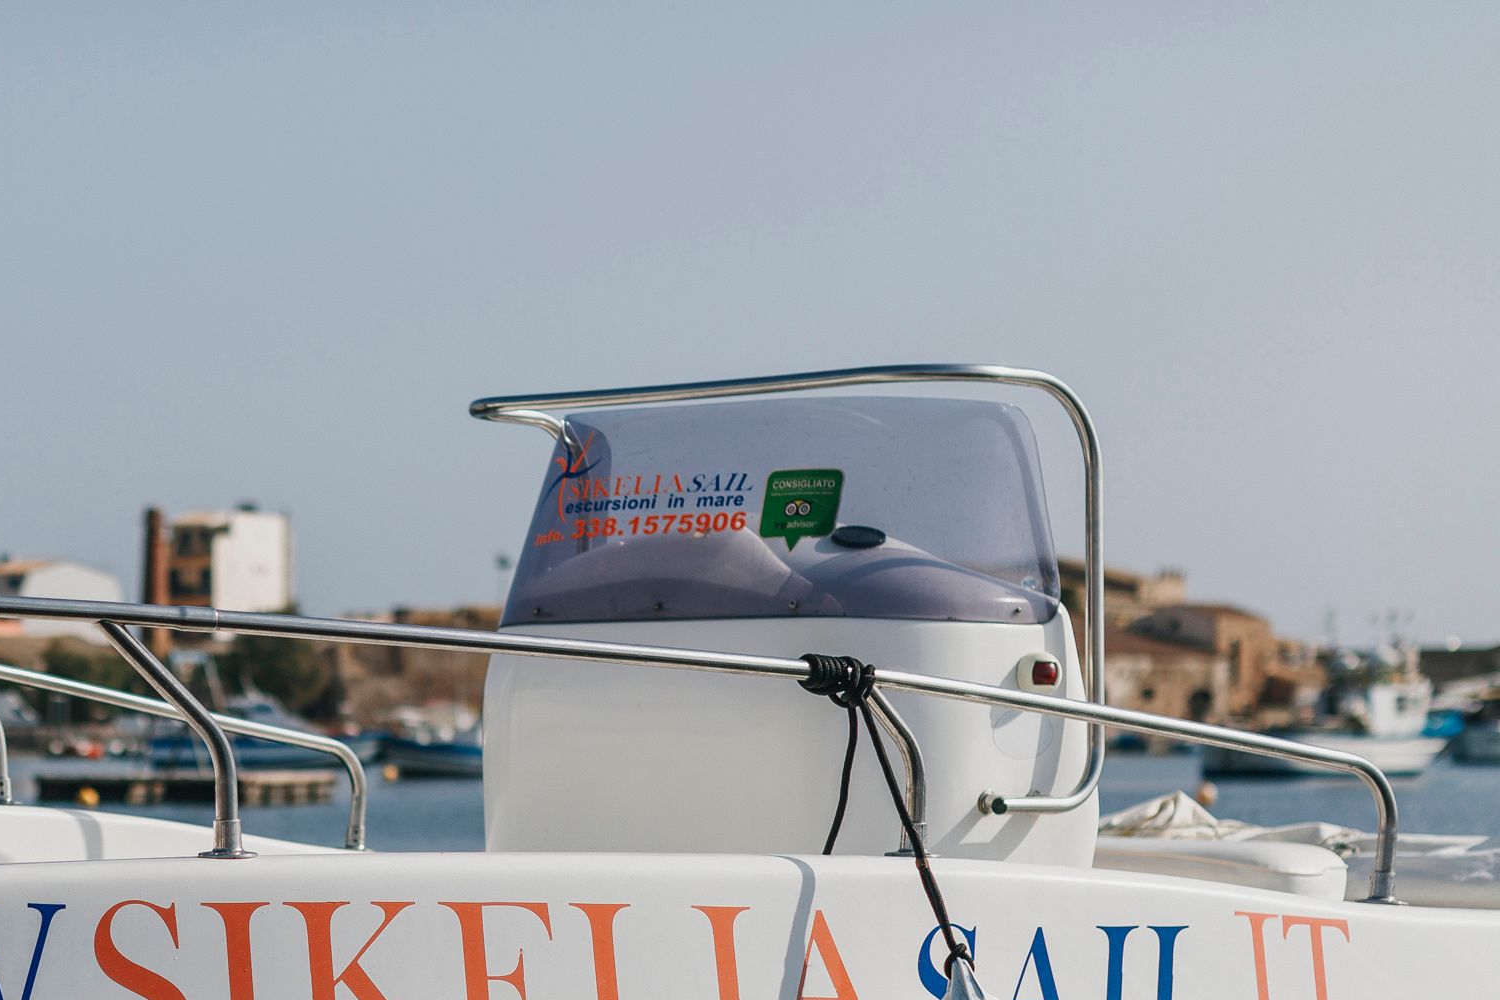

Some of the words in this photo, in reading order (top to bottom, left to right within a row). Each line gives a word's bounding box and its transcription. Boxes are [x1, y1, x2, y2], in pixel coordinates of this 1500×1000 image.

[772, 479, 836, 489] CONSIGLIATO
[565, 493, 657, 514] escursioni
[667, 493, 686, 509] in
[696, 494, 745, 508] mare
[570, 511, 748, 540] 338.1575906
